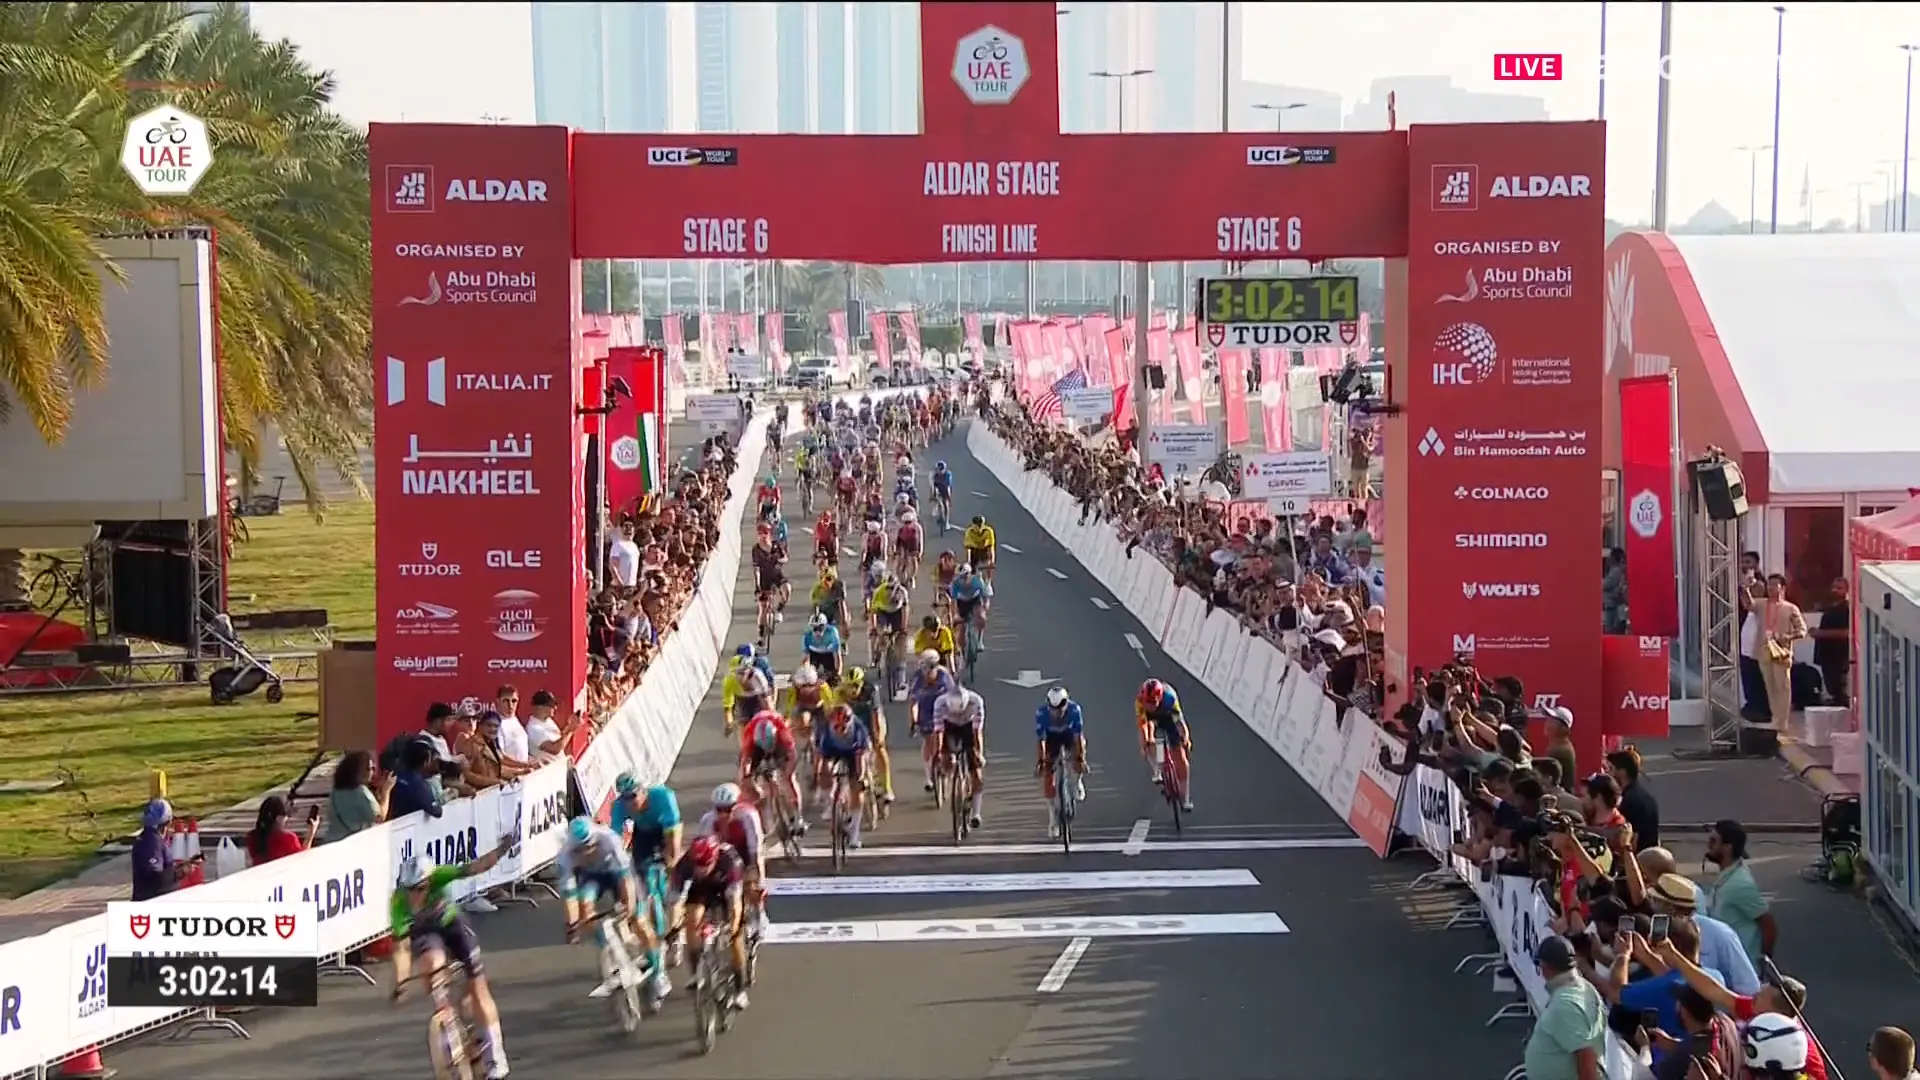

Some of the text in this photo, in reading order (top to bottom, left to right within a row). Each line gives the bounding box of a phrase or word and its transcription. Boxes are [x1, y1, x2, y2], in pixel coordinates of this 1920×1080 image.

[967, 62, 1013, 80] UAE
[973, 81, 1008, 93] TOUR
[652, 151, 682, 163] UCI
[705, 150, 731, 158] WORLD
[1251, 150, 1280, 162] UCI
[923, 161, 1060, 196] ALDAR STAGE
[1489, 174, 1592, 197] ALDAR
[445, 179, 548, 202] ALDAR
[683, 217, 769, 253] STAGE 6
[942, 224, 1038, 253] FINISH LINE
[1217, 216, 1301, 252] STAGE 6
[395, 244, 525, 258] ORGANISED BY
[1434, 240, 1561, 255] ORGANISED BY
[446, 271, 536, 288] Abu Dhabi
[1483, 266, 1572, 283] Abu Dhabi
[446, 288, 537, 305] Sports Council
[1482, 284, 1572, 301] Sports Council
[1232, 324, 1333, 345] TUDOR
[1512, 357, 1571, 367] International
[456, 374, 553, 391] ITALIA.IT
[1433, 363, 1473, 385] IHC
[402, 432, 533, 464] نخيل
[1454, 445, 1586, 456] Bin Hamoodah Auto
[402, 470, 541, 495] NAKHEEL
[1471, 487, 1549, 499] COLNAGO
[1281, 500, 1295, 512] 10
[1455, 533, 1548, 547] SHIMANO
[398, 564, 462, 576] TUDOR
[1478, 583, 1540, 597] WOLFI'S
[915, 919, 1187, 934] ALDAR
